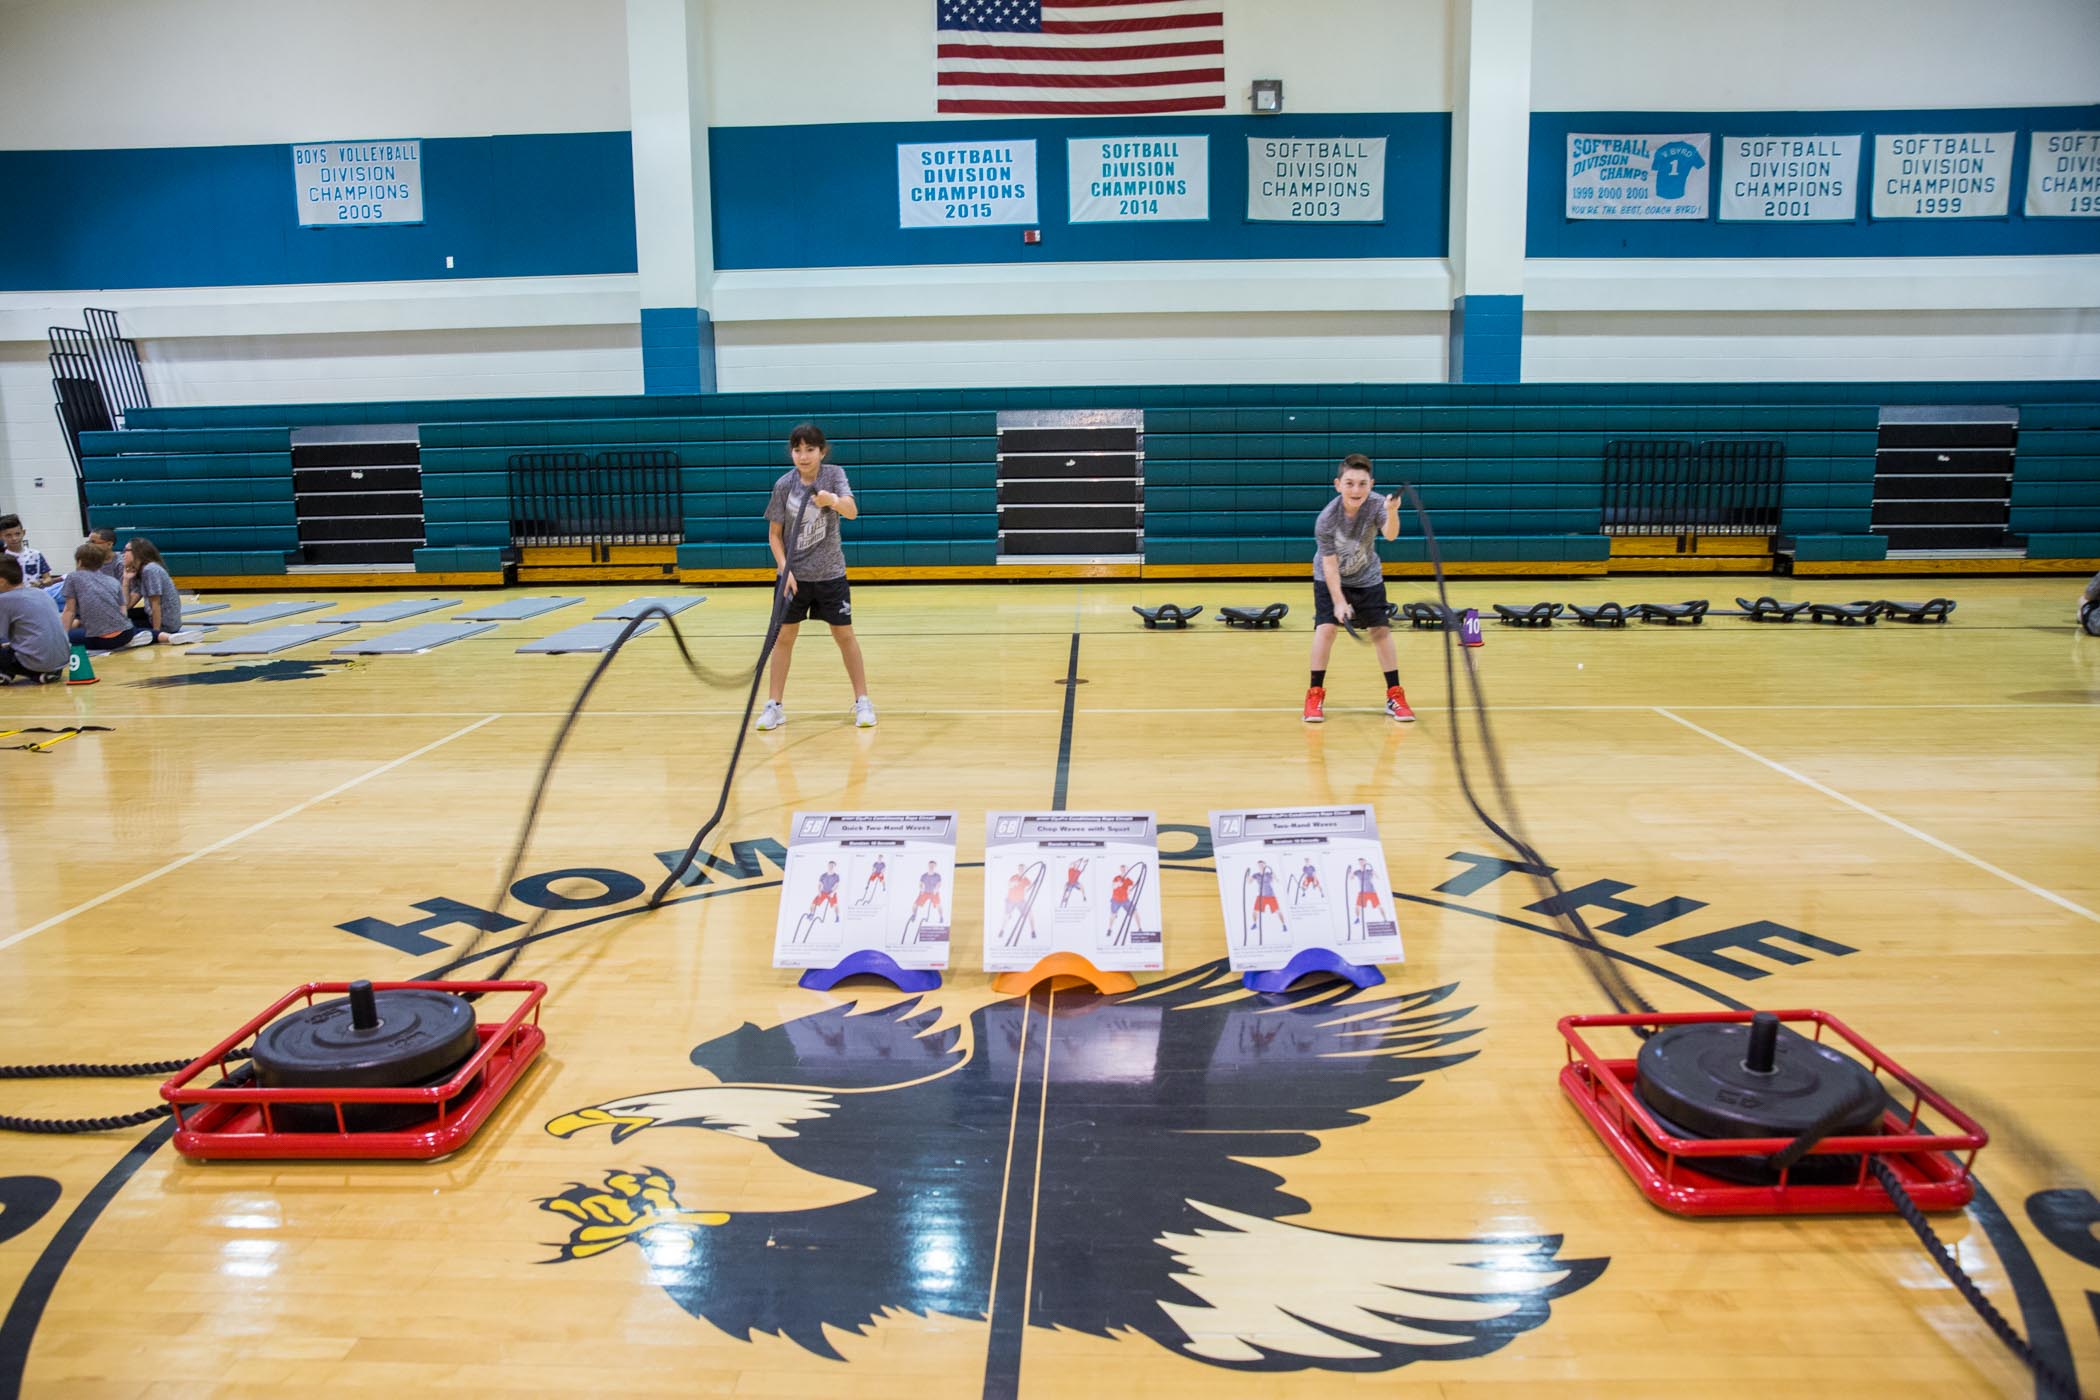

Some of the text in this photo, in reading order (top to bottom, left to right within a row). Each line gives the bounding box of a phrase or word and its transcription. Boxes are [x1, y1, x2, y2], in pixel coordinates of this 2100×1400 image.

[1102, 143, 1179, 158] SOFTBALL
[1266, 142, 1368, 158] SOFTBALL
[1573, 138, 1650, 158] SOFTBALL
[1740, 141, 1842, 157] SOFTBALL
[1893, 138, 1996, 154] SOFTBALL
[297, 146, 417, 164] BOYS VOLLEYBALL
[922, 149, 1013, 165] SOFTBALL
[1103, 162, 1175, 177] DIVISION
[1277, 162, 1357, 177] DIVISION
[1573, 155, 1629, 176] DIVISION
[1668, 159, 1679, 176] 1
[1750, 162, 1830, 177] DIVISION
[1903, 158, 1984, 174] DIVISION
[321, 167, 395, 182] DIVISION
[925, 167, 1011, 183] DIVISION
[1600, 167, 1648, 181] CHAMPS
[310, 185, 409, 201] CHAMPIONS
[912, 184, 1025, 201] CHAMPIONS
[1091, 180, 1186, 196] CHAMPIONS
[1263, 181, 1370, 197] CHAMPIONS
[1573, 188, 1648, 199] 1999 2000 2001
[1735, 181, 1842, 197] CHAMPIONS
[1887, 177, 1995, 194] CHAMPIONS
[339, 205, 382, 219] 2005
[946, 204, 991, 218] 2015
[1120, 200, 1158, 214] 2014
[1292, 202, 1340, 216] 2003
[1602, 206, 1616, 214] THE
[1645, 206, 1671, 214] COACH
[1765, 202, 1810, 216] 2001
[1915, 198, 1962, 213] 1999
[1466, 617, 1480, 634] 10
[69, 654, 80, 671] 9
[842, 824, 931, 832] Quick Two-Hand Waves
[1037, 825, 1057, 833] Chop
[1108, 825, 1130, 833] Squat
[1273, 822, 1310, 830] Two-Hand
[334, 837, 788, 956] HOM
[1433, 851, 1860, 980] THE
